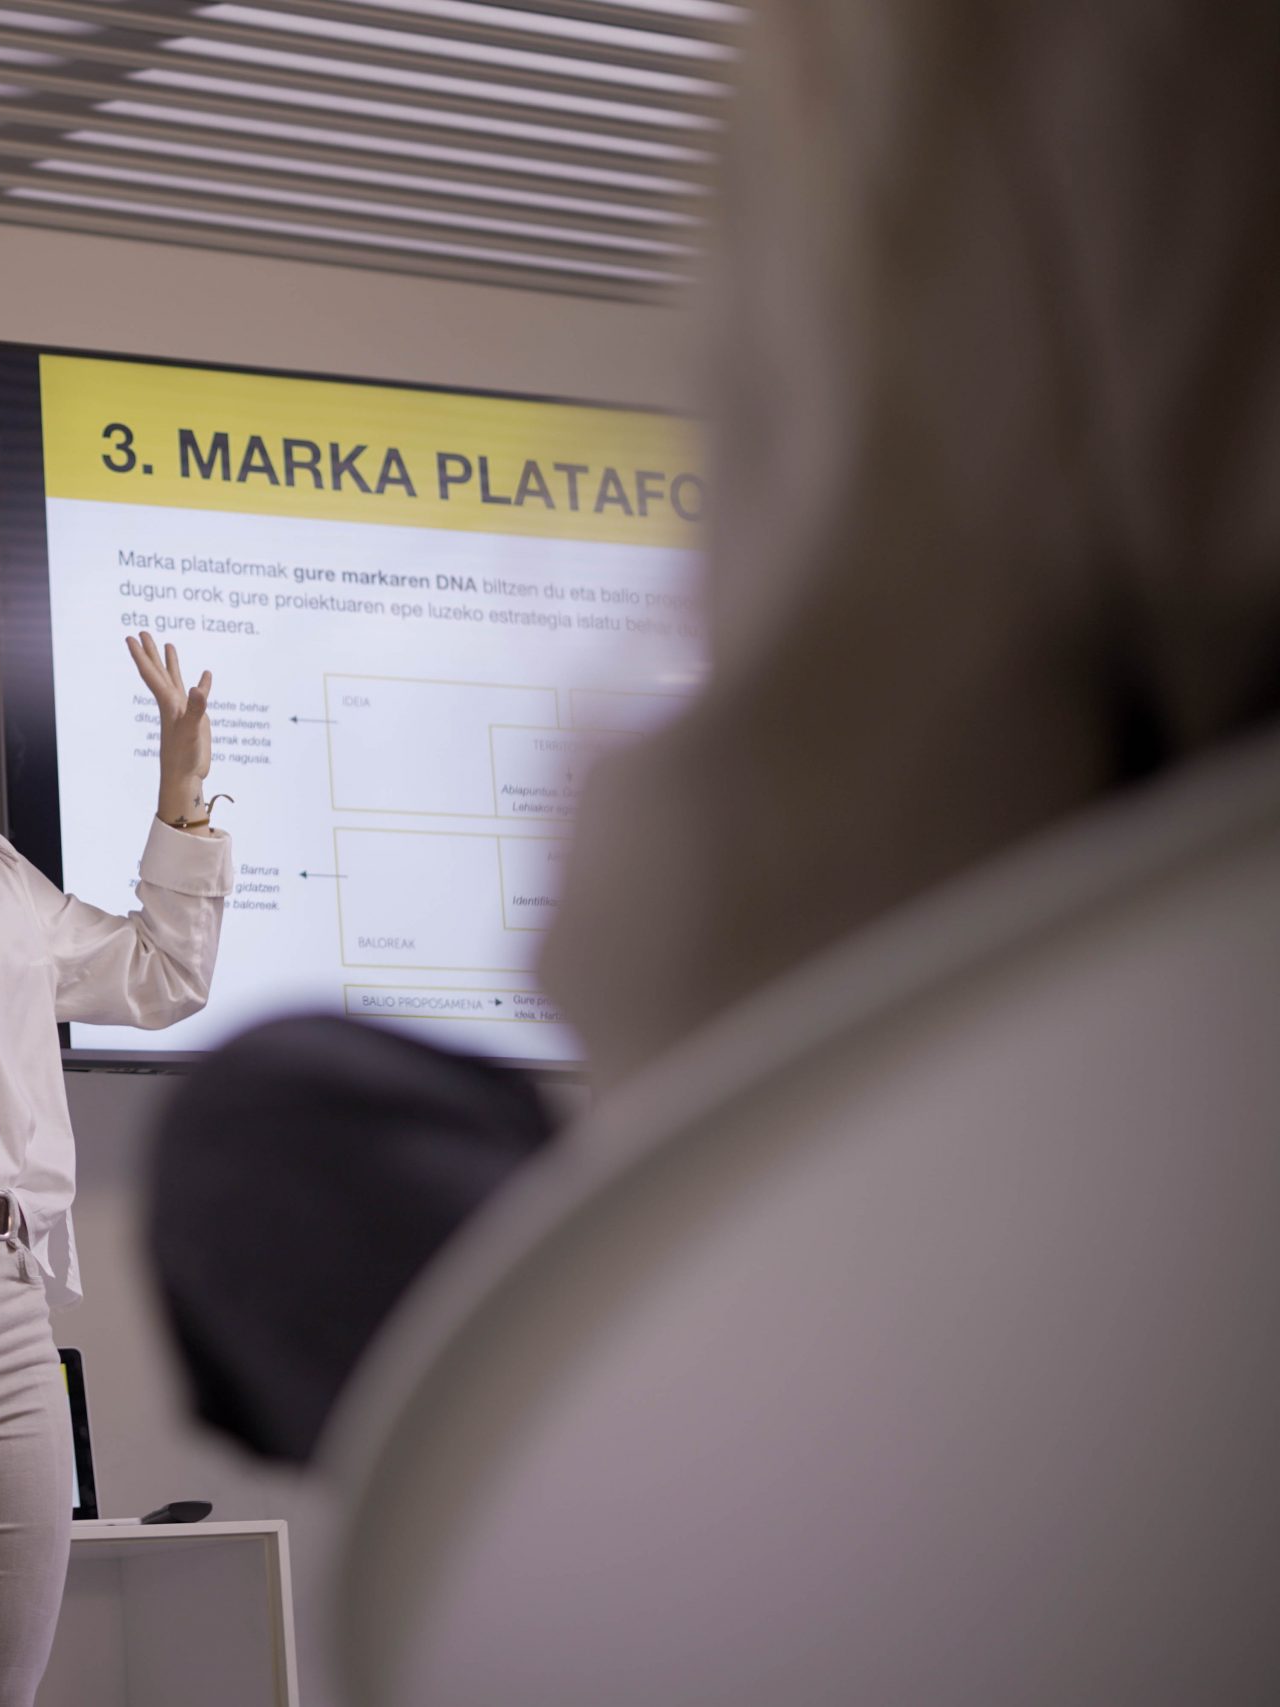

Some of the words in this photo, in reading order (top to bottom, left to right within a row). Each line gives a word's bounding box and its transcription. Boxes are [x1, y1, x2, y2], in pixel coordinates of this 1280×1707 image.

[101, 422, 154, 476] 3.
[178, 428, 418, 499] MARKA
[118, 549, 175, 571] Marka
[181, 554, 287, 579] plataformak
[293, 566, 335, 584] gure
[341, 569, 430, 589] markaren
[435, 574, 478, 593] DNA
[482, 577, 538, 597] biltzen
[543, 581, 565, 600] du
[570, 586, 596, 602] eta
[600, 587, 640, 605] balio
[119, 579, 177, 603] dugun
[183, 586, 223, 603] orok
[229, 591, 269, 609] gure
[275, 592, 384, 615] proiektuaren
[390, 602, 423, 620] epe
[428, 602, 484, 623] luzeko
[489, 607, 572, 631] estrategia
[577, 612, 620, 632] islatu
[120, 610, 149, 627] eta
[154, 613, 196, 633] gure
[201, 614, 260, 636] izaera.
[341, 695, 370, 708] IDEIA
[241, 736, 271, 747] edota
[240, 864, 279, 876] Barrura
[358, 936, 415, 950] BALOREAK
[362, 995, 395, 1008] BALIO
[398, 995, 484, 1011] PROPOSAMENA
